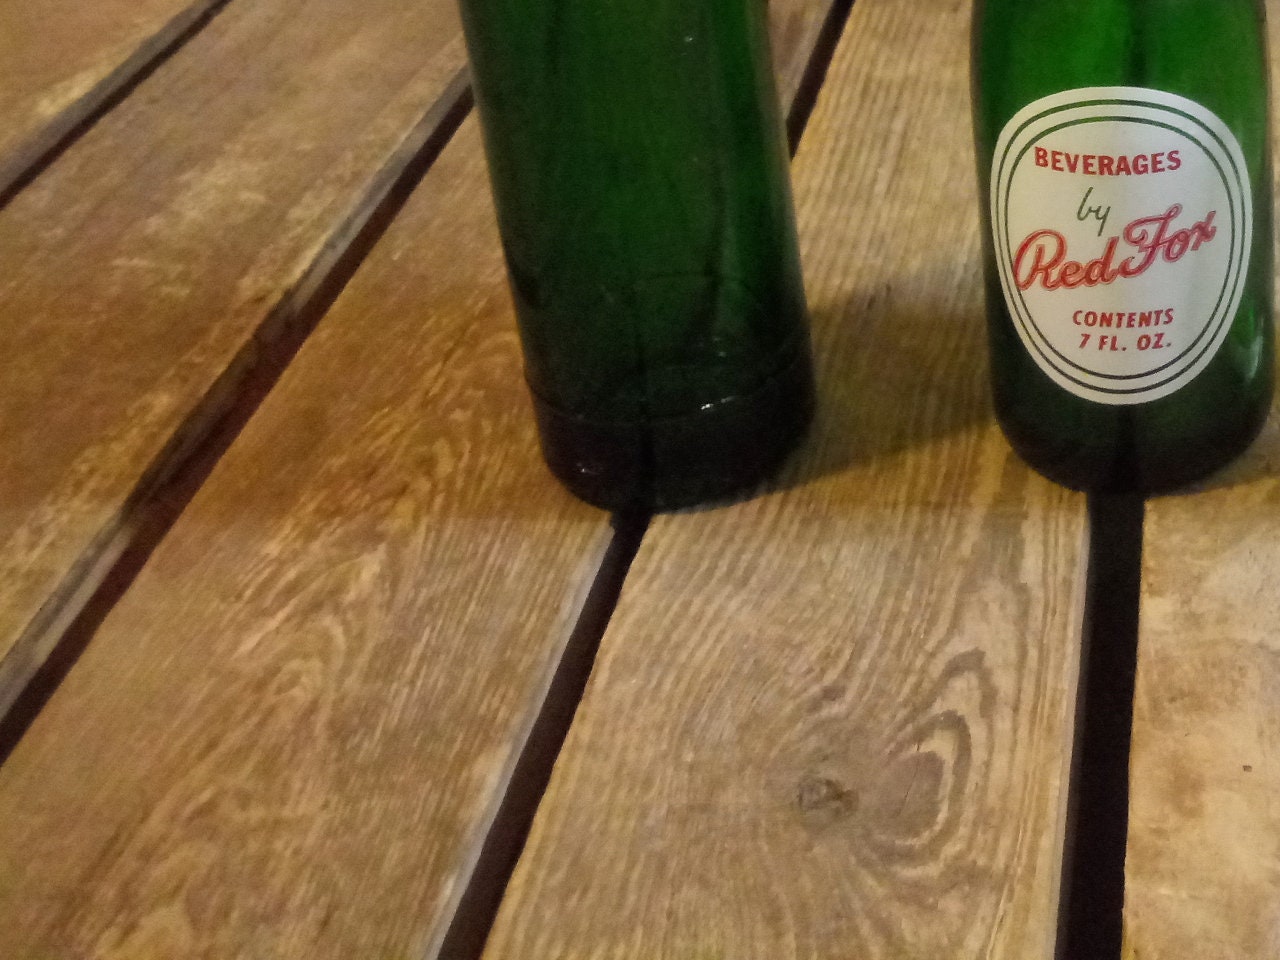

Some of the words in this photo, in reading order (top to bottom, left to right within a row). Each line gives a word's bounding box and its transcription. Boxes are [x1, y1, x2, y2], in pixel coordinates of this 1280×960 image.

[1034, 146, 1182, 176] BEVERAGES
[1077, 187, 1112, 237] by
[1012, 228, 1120, 292] Red
[1119, 203, 1217, 280] Fox
[1072, 307, 1175, 329] CONTENTS
[1079, 333, 1092, 349] 7
[1098, 334, 1128, 352] FL.
[1136, 332, 1172, 351] OZ.
